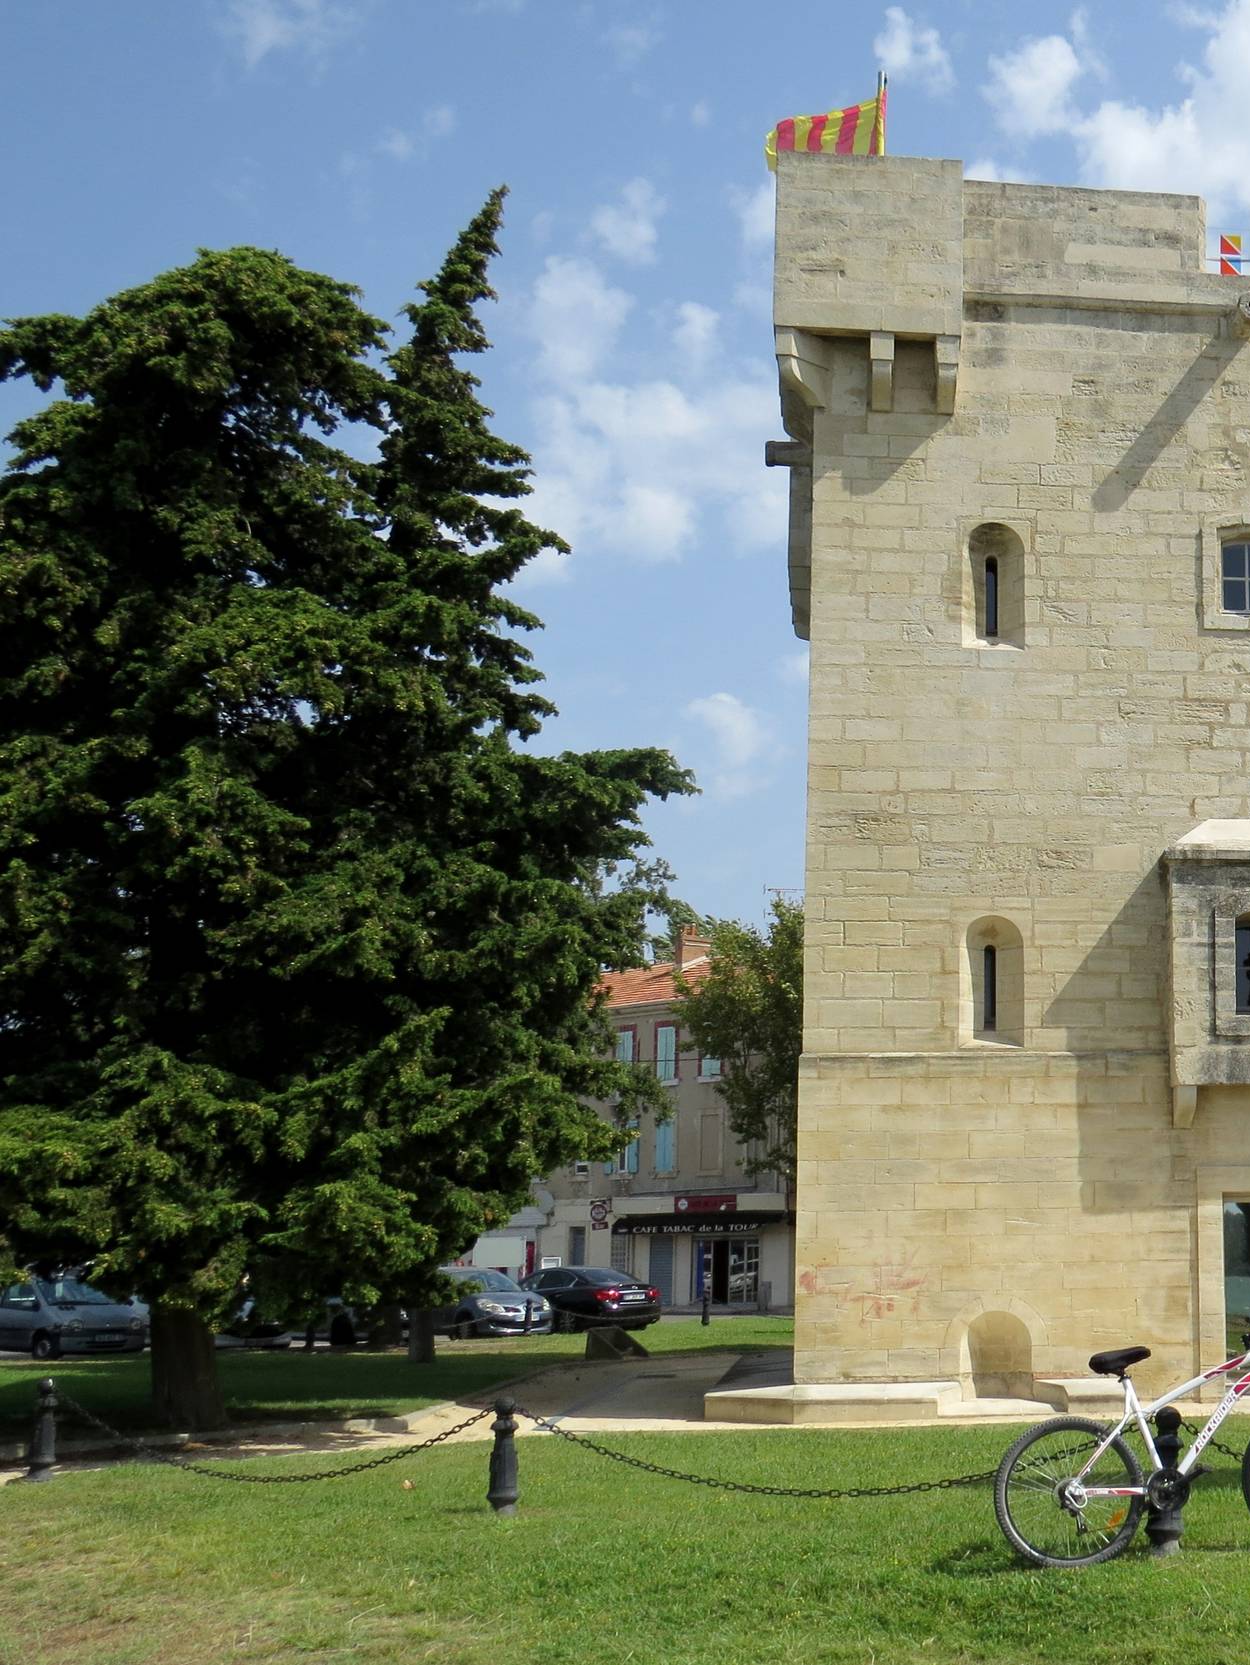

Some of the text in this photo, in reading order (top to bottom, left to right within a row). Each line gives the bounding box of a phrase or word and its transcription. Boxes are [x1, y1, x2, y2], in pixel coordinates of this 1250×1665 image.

[632, 1226, 657, 1234] CAFE
[663, 1225, 695, 1233] TABAC
[699, 1224, 712, 1232] de
[714, 1224, 724, 1232] la
[1196, 1391, 1237, 1450] ROCKRIDER
